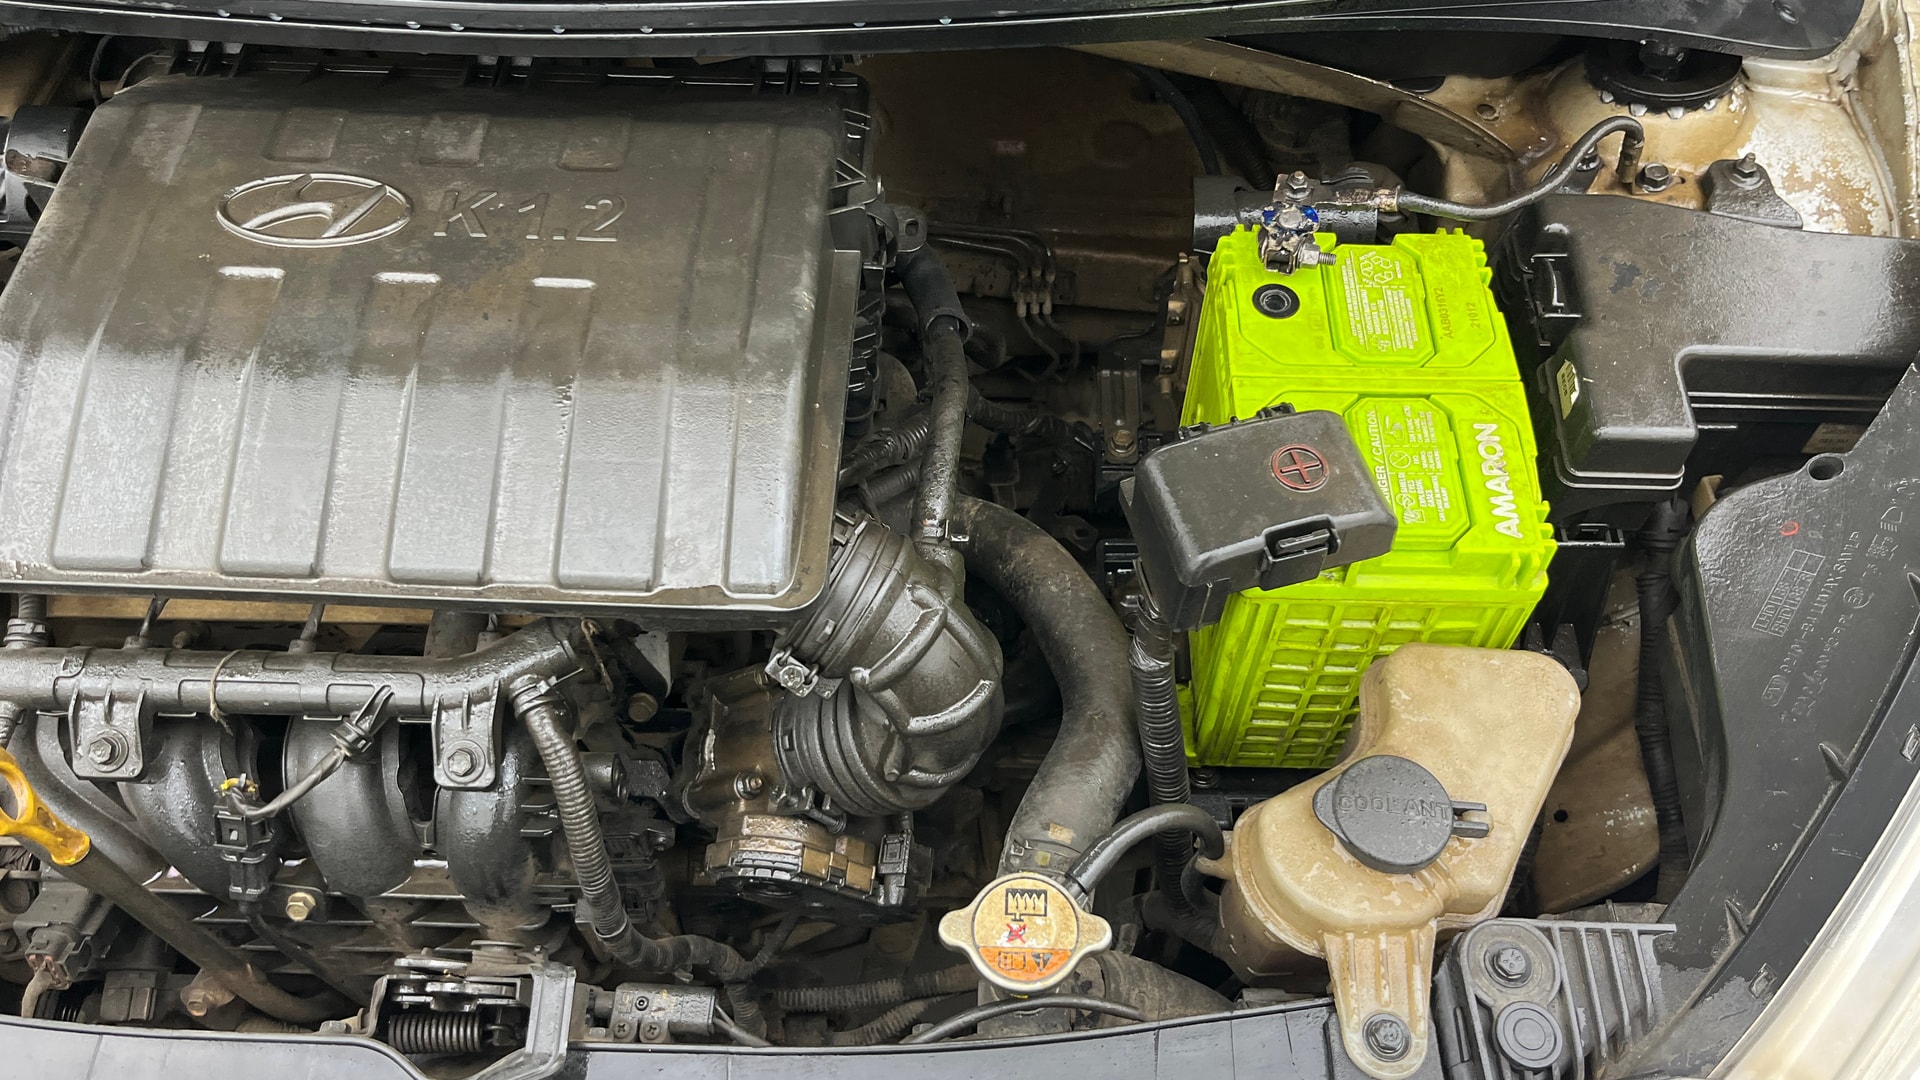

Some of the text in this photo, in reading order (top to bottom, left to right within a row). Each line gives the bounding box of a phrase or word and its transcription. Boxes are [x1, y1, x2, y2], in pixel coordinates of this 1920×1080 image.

[1467, 303, 1480, 328] 21012
[1366, 410, 1382, 456] CAUTION
[1473, 423, 1523, 538] AMARON
[1338, 795, 1450, 819] COOLANT
